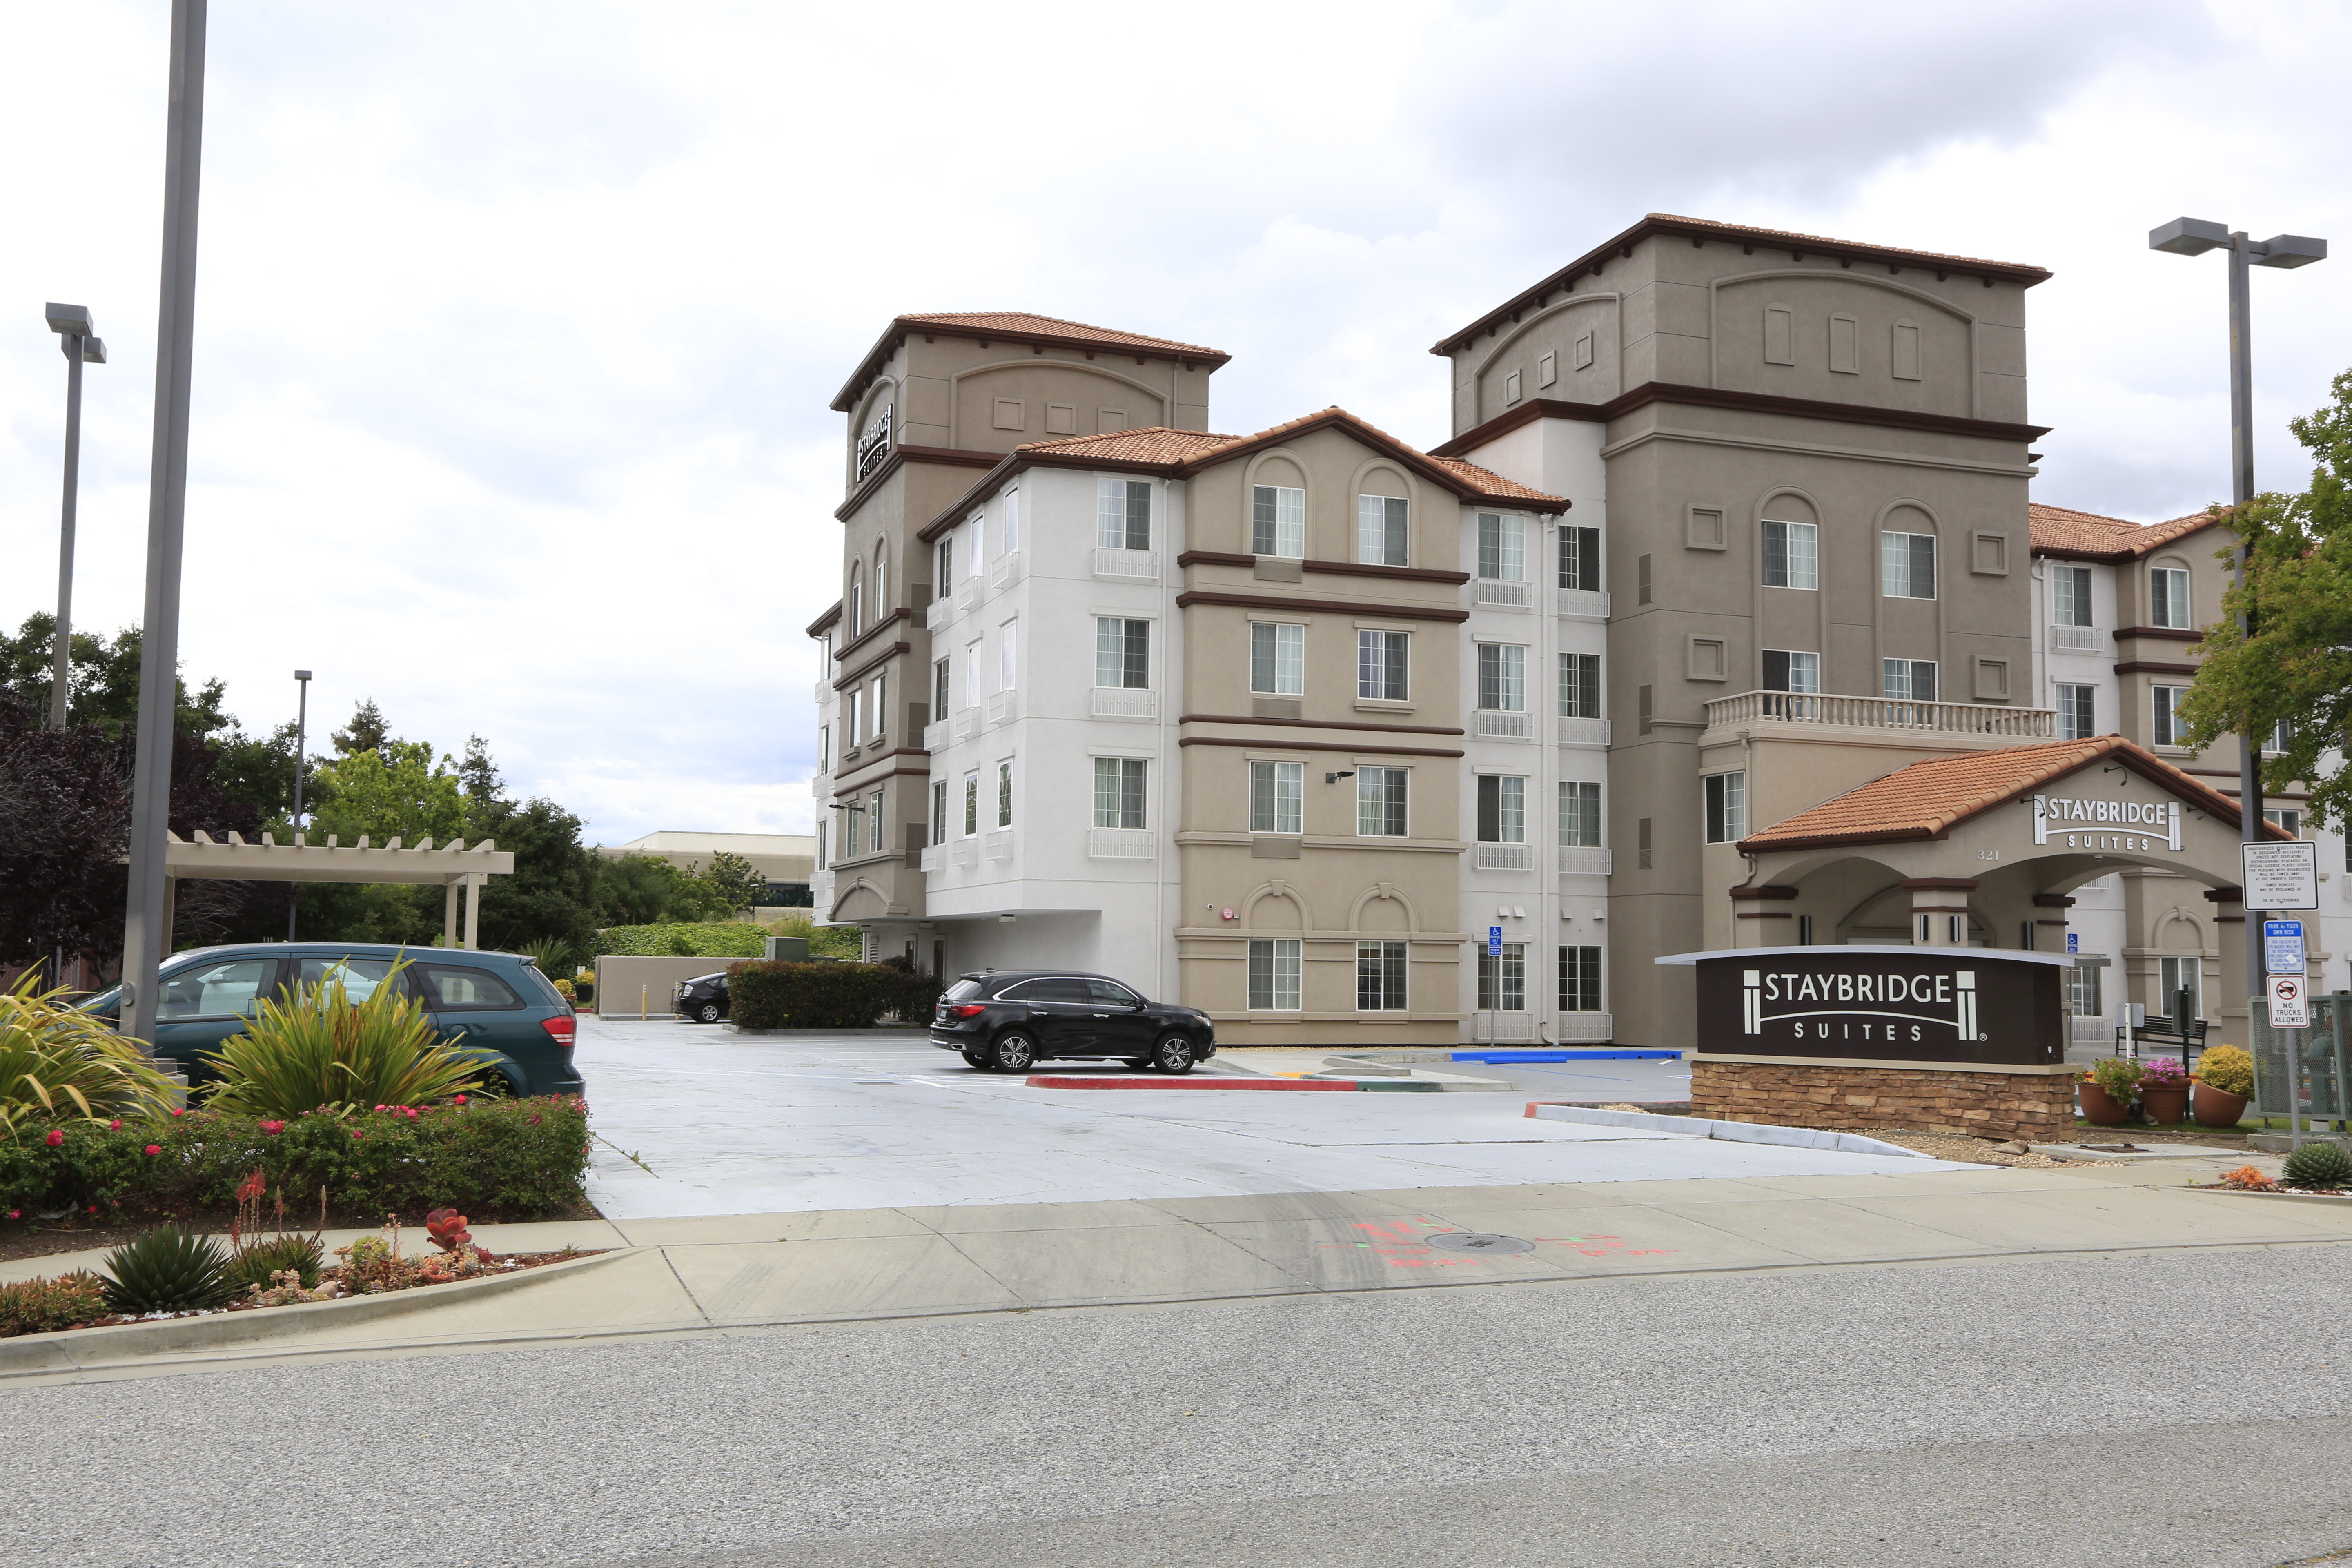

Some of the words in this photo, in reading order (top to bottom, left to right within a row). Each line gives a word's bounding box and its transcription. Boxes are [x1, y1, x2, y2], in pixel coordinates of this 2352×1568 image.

[860, 411, 887, 457] STAYBRIDGE
[864, 448, 882, 476] SUITES
[2049, 798, 2166, 824] STAYBRIDGE
[1977, 850, 1999, 860] 321
[2068, 835, 2149, 851] SUITES
[1765, 973, 1951, 1003] STAYBRIDGE
[1794, 1022, 1921, 1041] SUITES
